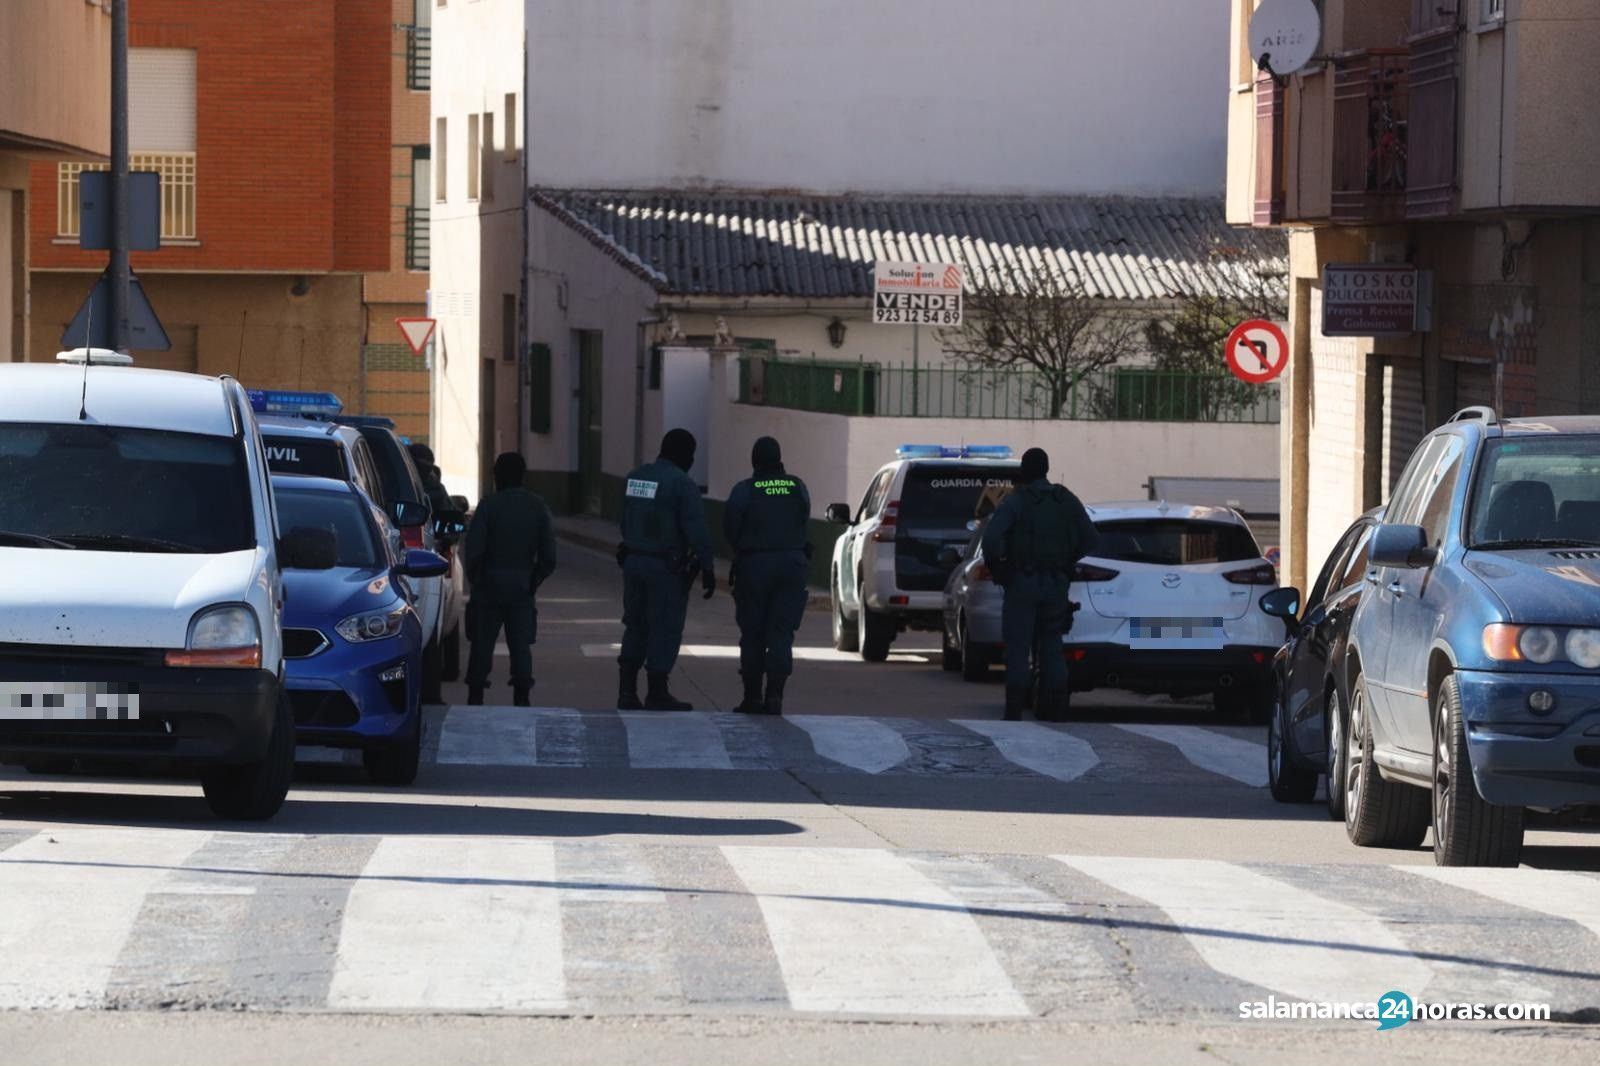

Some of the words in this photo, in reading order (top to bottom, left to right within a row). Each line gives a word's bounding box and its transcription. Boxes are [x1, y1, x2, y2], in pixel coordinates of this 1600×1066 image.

[1328, 273, 1414, 287] KIOSKO
[1327, 289, 1414, 301] DULCEMANIA
[880, 294, 956, 310] VENDE
[1327, 306, 1362, 316] Prensa
[877, 309, 900, 322] 923
[904, 310, 918, 323] 12
[923, 311, 939, 323] 54
[943, 312, 960, 324] 89
[1343, 318, 1397, 329] Golosinas
[629, 480, 657, 490] GUARDIA
[754, 479, 796, 488] GUARDIA
[931, 478, 983, 488] GUARDIA
[986, 479, 1014, 488] CIVIL
[633, 488, 649, 497] CIVIL
[765, 487, 790, 496] CIVIL
